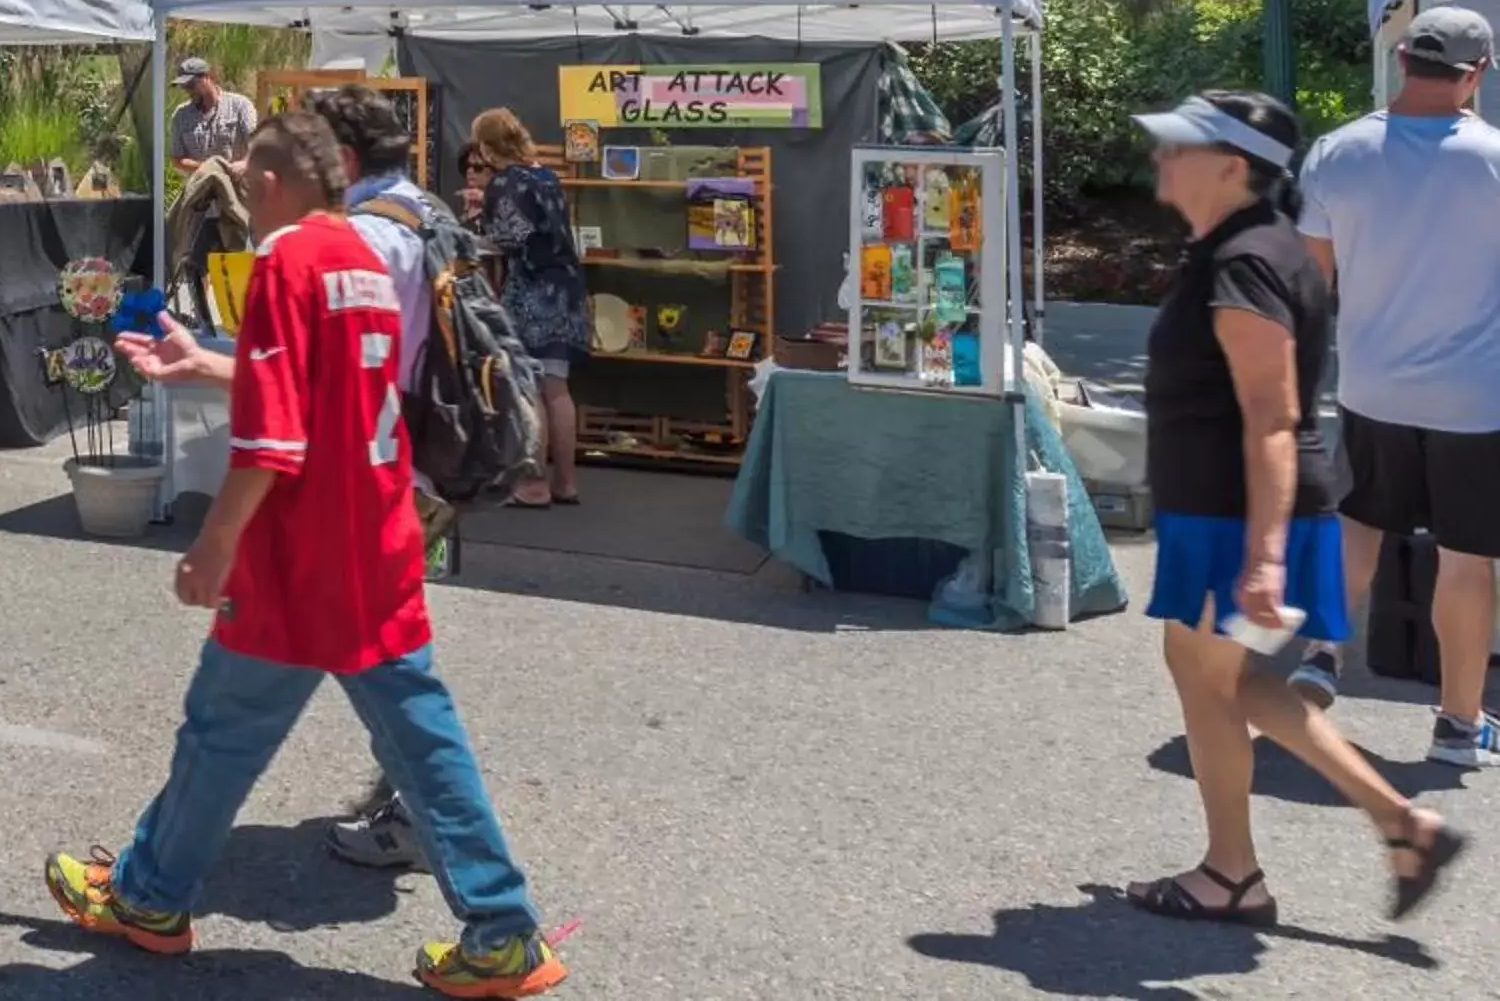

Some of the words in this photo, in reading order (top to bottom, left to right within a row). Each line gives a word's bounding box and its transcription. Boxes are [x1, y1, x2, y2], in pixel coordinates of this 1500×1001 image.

[588, 70, 647, 93] ART
[667, 71, 786, 96] ATTACK
[621, 99, 728, 123] GLASS
